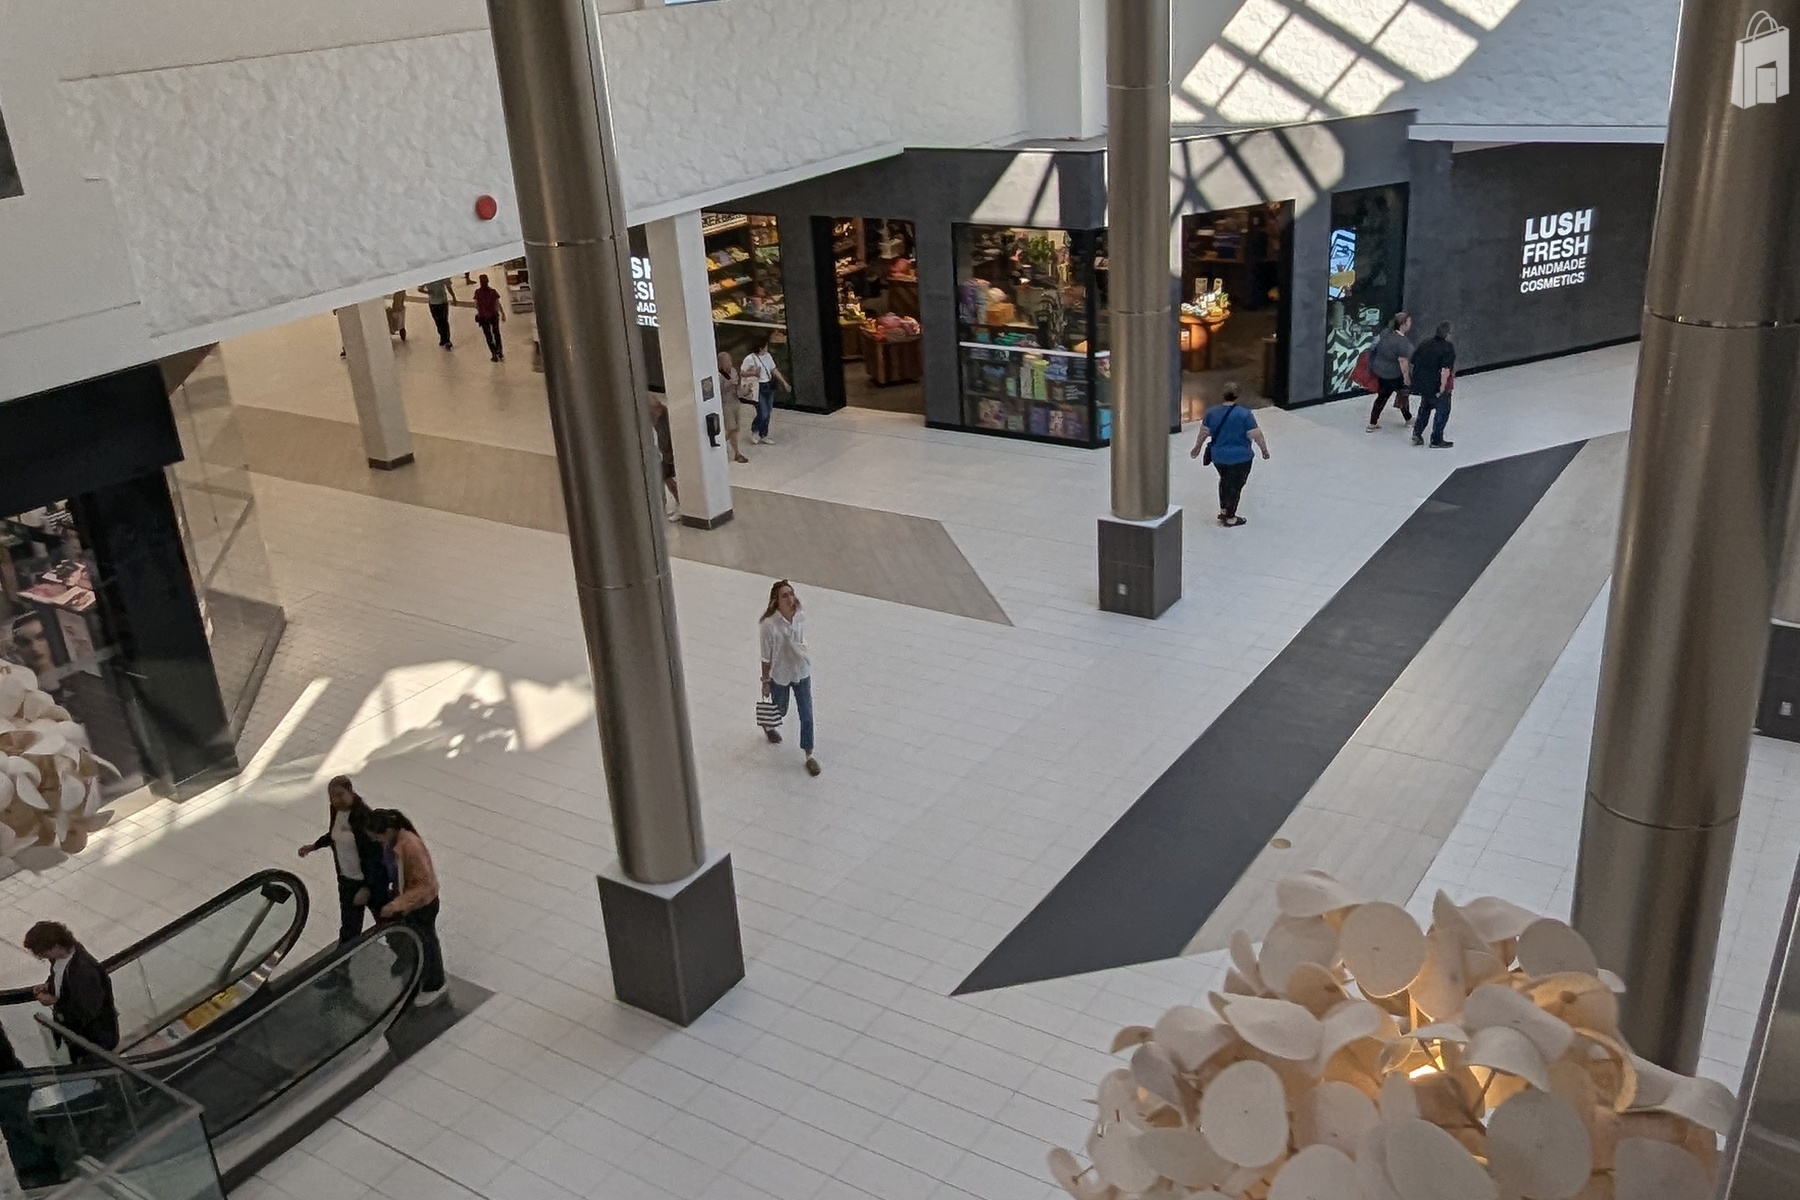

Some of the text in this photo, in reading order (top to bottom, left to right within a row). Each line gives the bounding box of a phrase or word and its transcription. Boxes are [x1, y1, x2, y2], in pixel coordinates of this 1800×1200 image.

[1525, 209, 1592, 241] LUSH
[1522, 235, 1589, 264] FRESH
[1521, 257, 1586, 279] HANDMADE
[1520, 272, 1585, 293] COSMETICS
